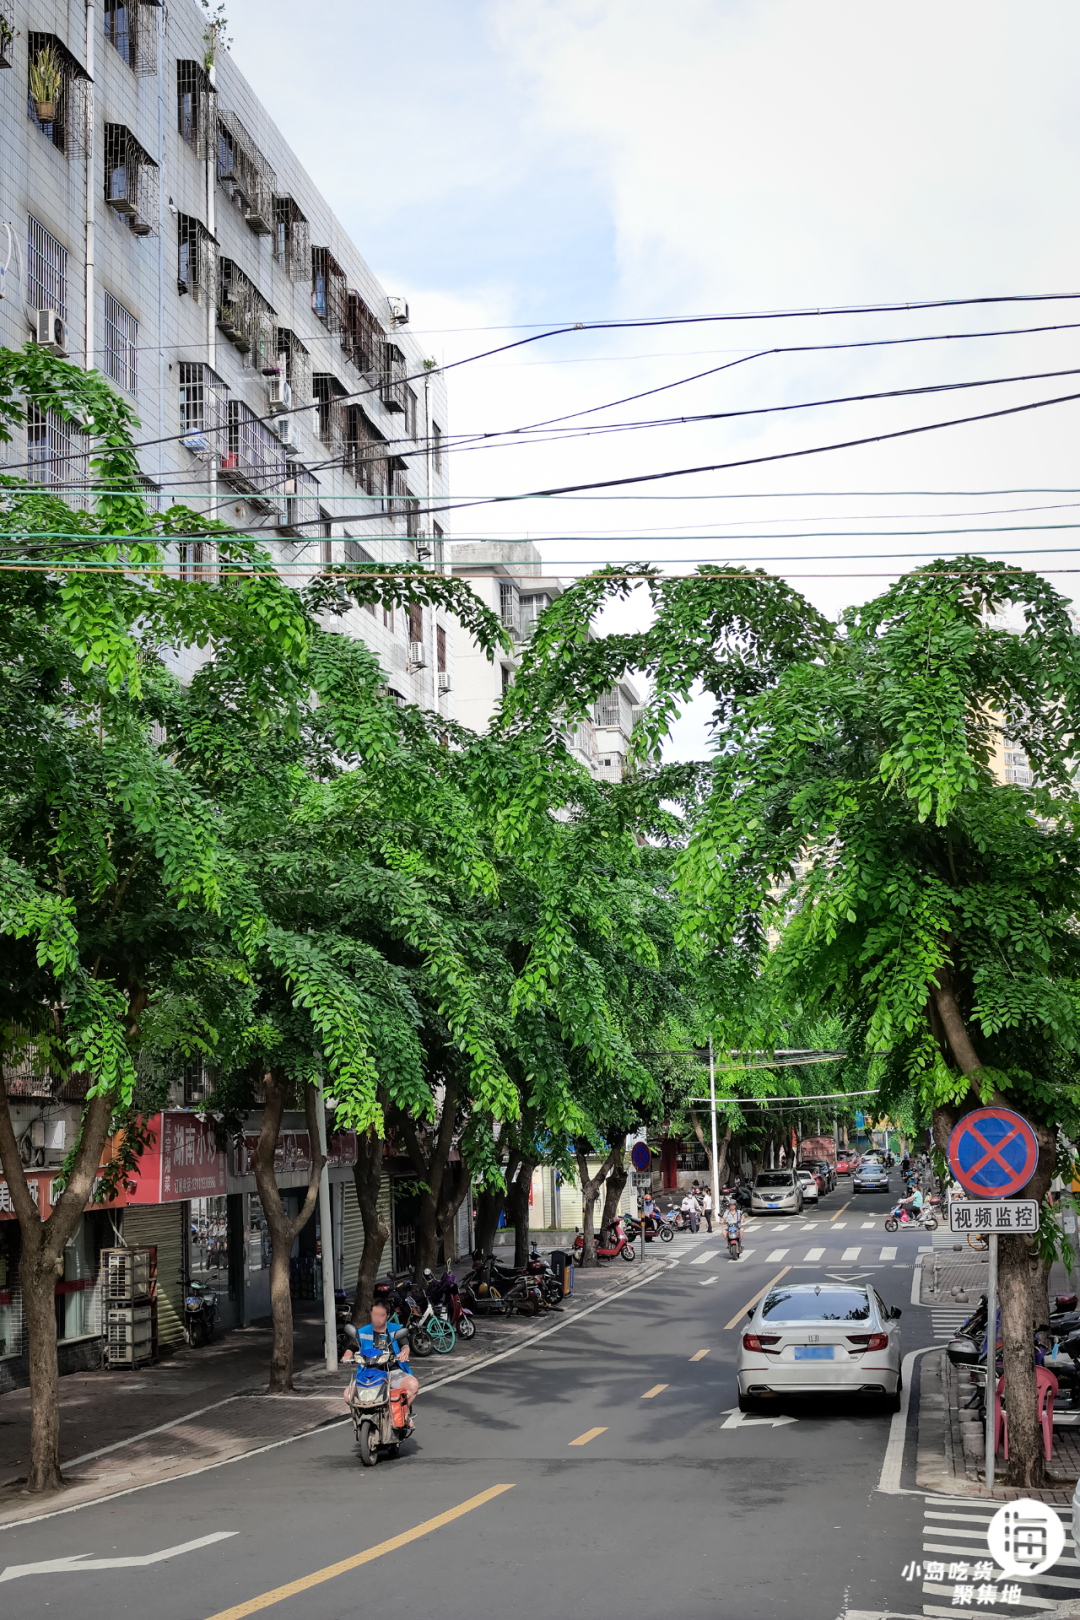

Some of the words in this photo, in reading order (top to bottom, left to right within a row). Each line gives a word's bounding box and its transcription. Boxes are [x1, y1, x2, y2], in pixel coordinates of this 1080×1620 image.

[173, 1123, 217, 1167] 湖南小炒
[954, 1206, 1033, 1228] 视频监控
